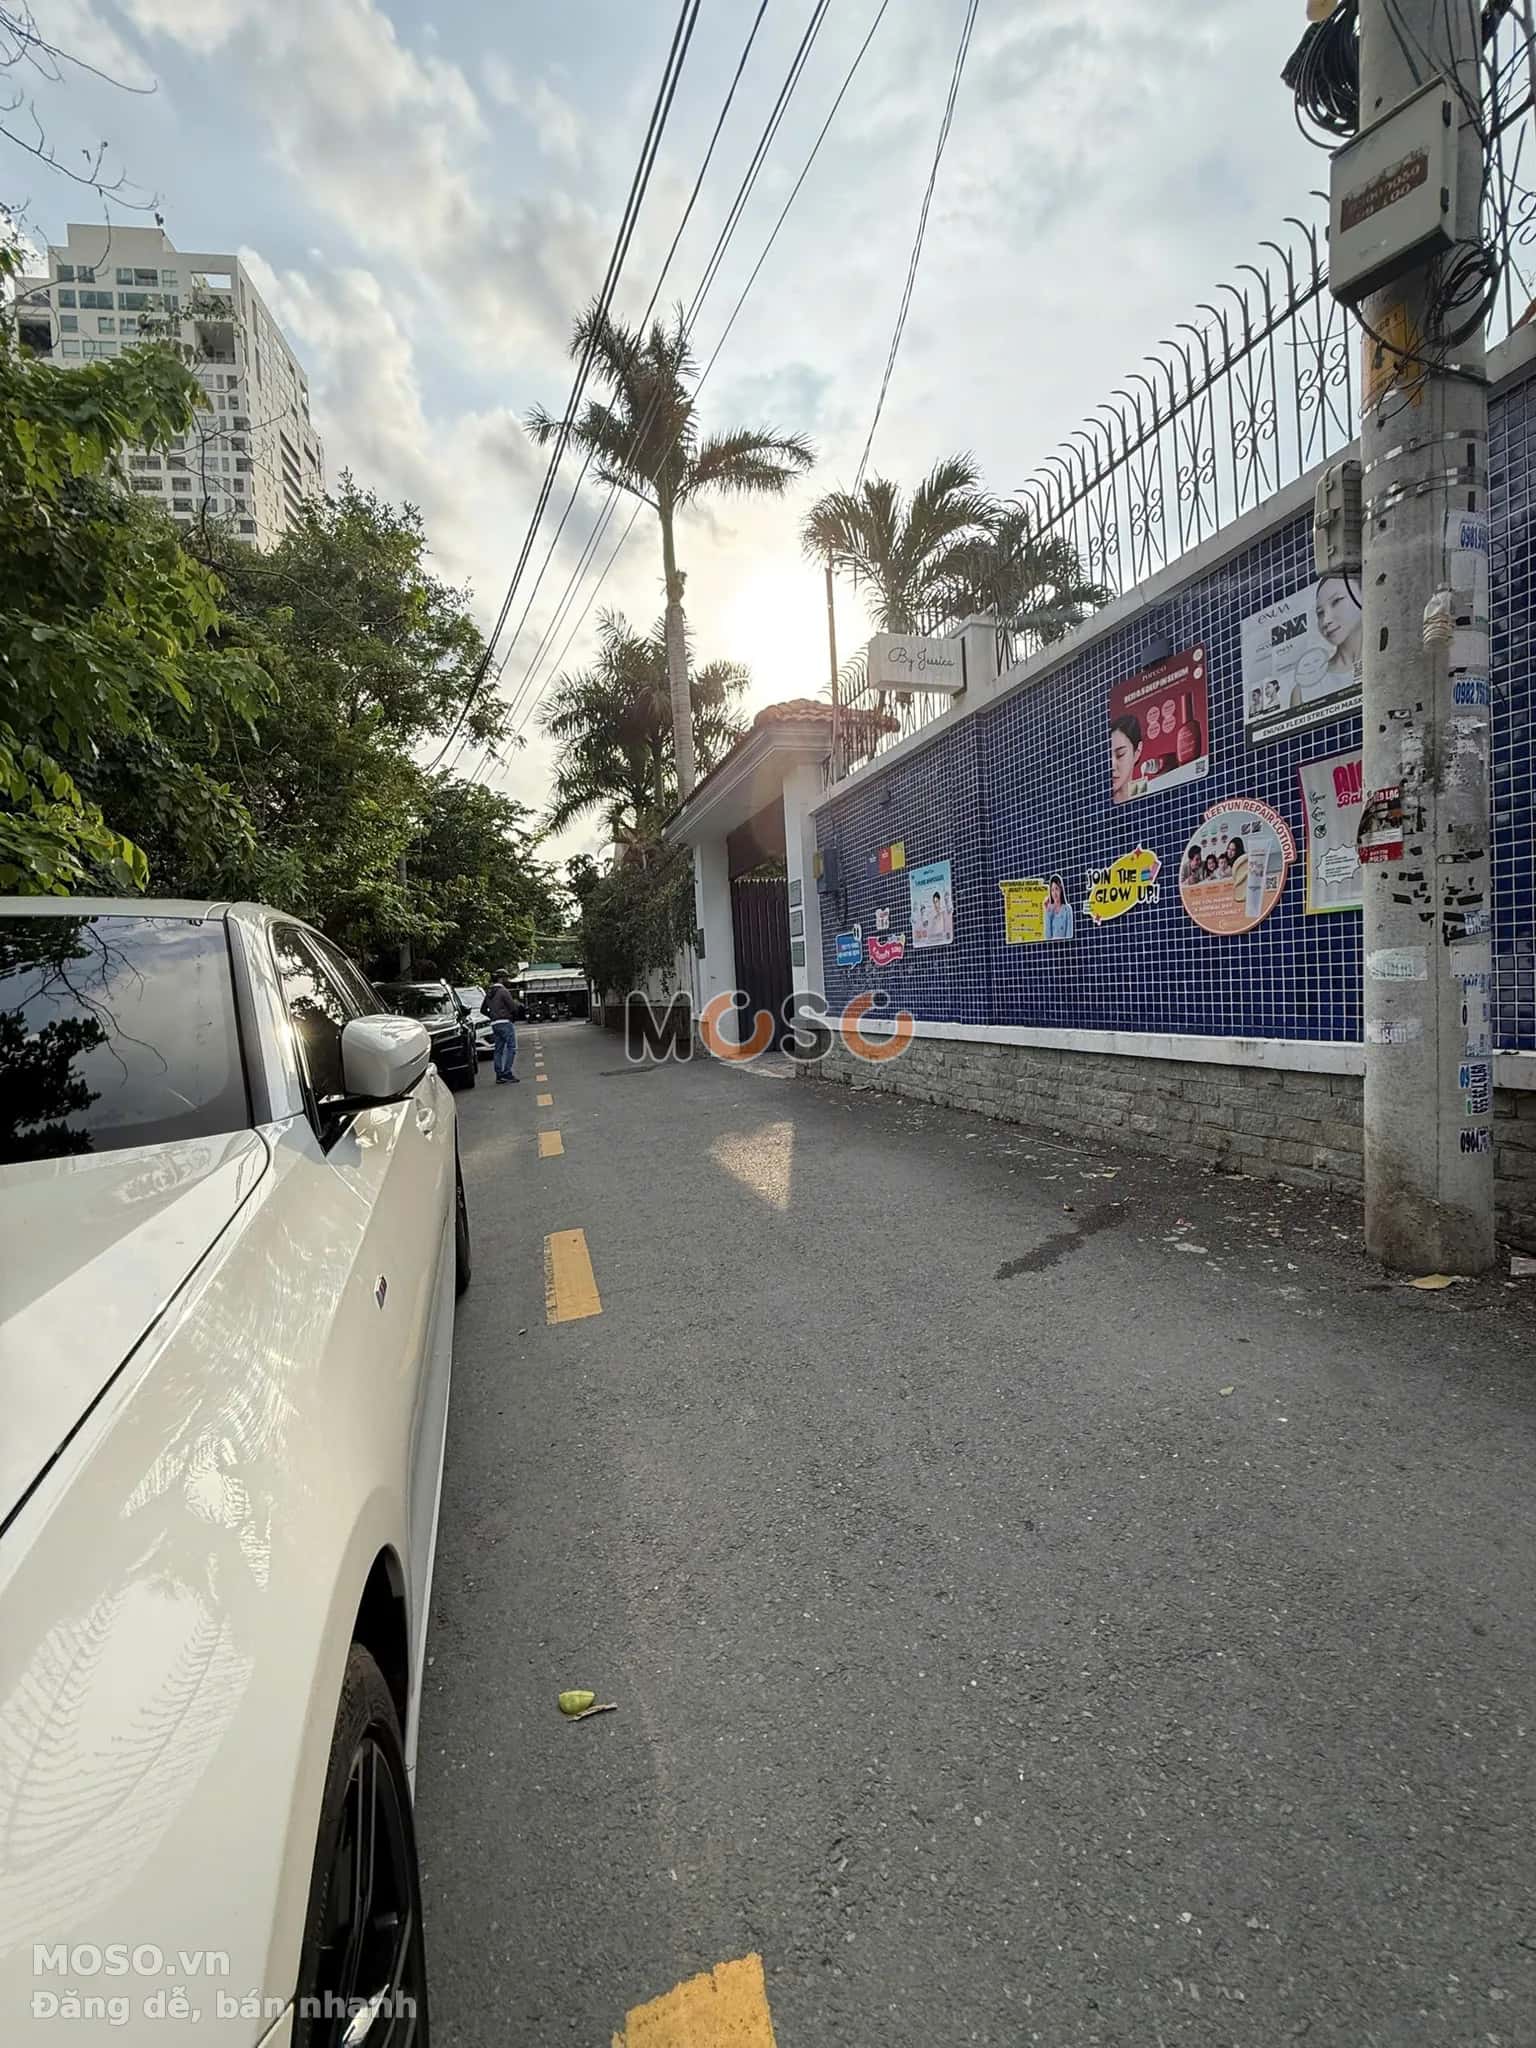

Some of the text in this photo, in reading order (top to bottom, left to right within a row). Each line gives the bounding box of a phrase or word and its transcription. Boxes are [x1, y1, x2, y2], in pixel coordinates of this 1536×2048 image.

[888, 647, 913, 672] By
[1286, 716, 1306, 729] FLEXI
[1307, 704, 1340, 722] STRETCH
[1341, 696, 1363, 710] MASK
[1205, 801, 1293, 860] LEEYUN REPAIR LOTION
[1087, 868, 1136, 889] JOIN THE
[1095, 885, 1158, 904] GLOW UP!
